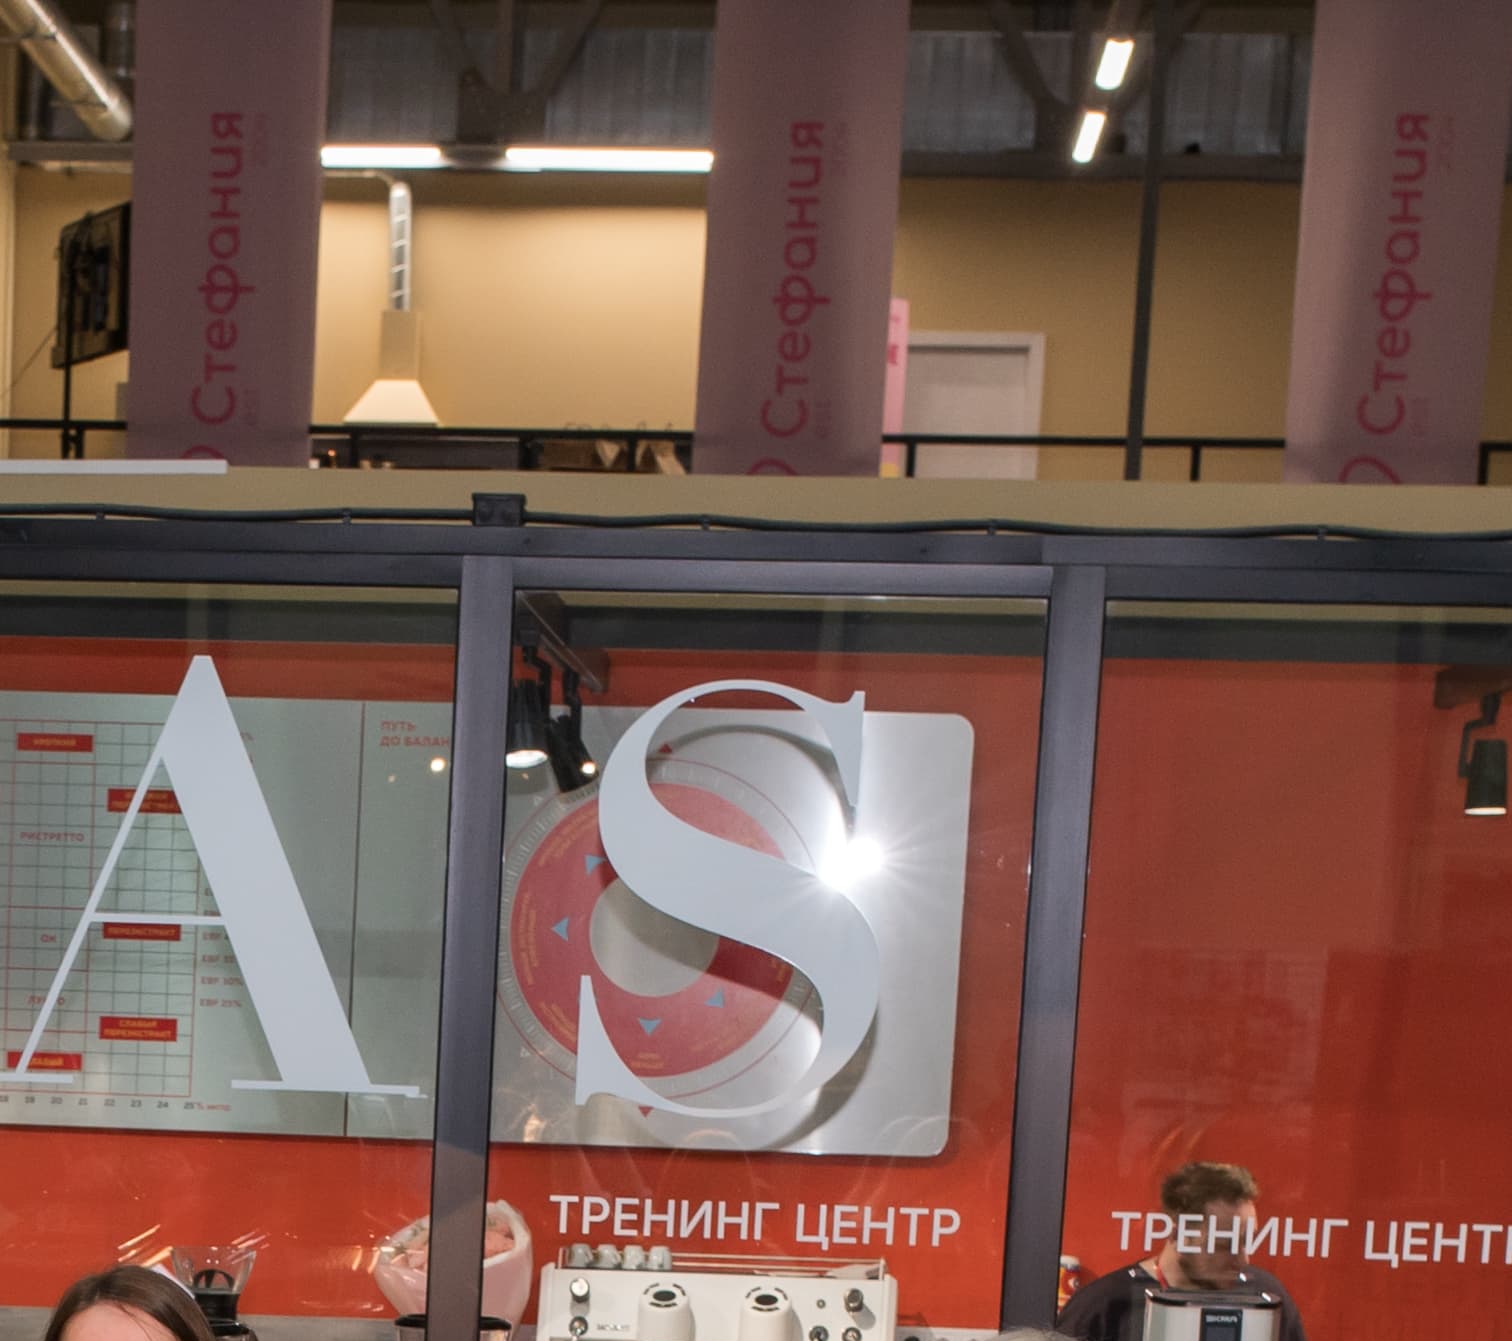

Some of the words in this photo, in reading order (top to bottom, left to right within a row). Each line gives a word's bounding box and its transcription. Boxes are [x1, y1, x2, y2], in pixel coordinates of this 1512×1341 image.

[191, 112, 255, 425] Стефания
[761, 121, 830, 438] Стефания
[1357, 113, 1431, 436] Стефания
[380, 720, 416, 732] ПУТЬ
[380, 736, 401, 747] ДО
[404, 736, 451, 747] БАЛАН
[548, 1193, 780, 1245] ТРЕНИНГ
[794, 1204, 963, 1255] ЦЕНТР
[1110, 1209, 1348, 1262] ТРЕНИНГ
